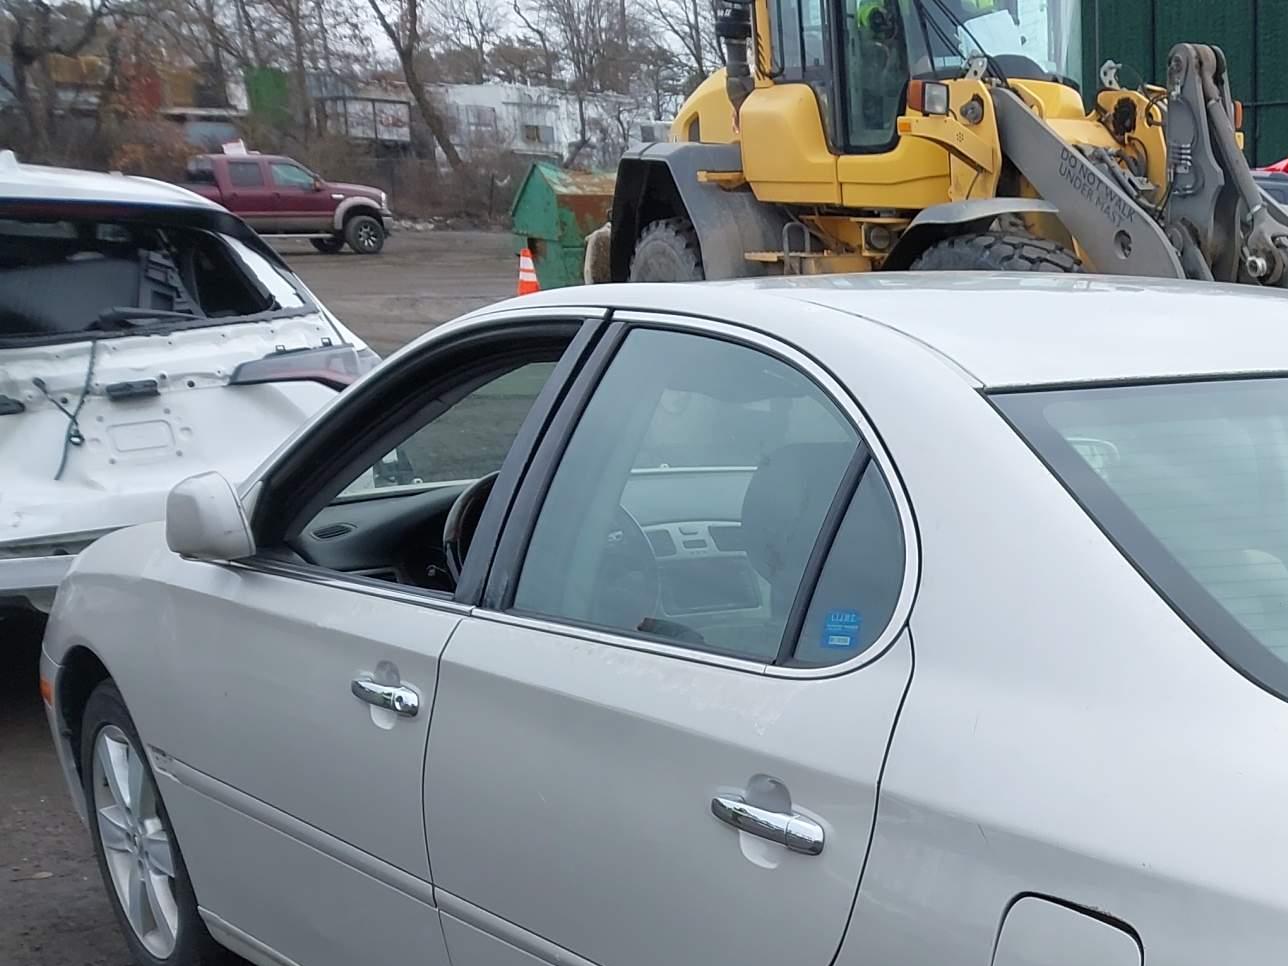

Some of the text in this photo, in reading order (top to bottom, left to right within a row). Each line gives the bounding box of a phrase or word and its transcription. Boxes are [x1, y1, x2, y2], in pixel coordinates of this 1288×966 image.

[1058, 162, 1122, 227] UNDER MAST
[1061, 147, 1136, 222] DO NOT WALK
